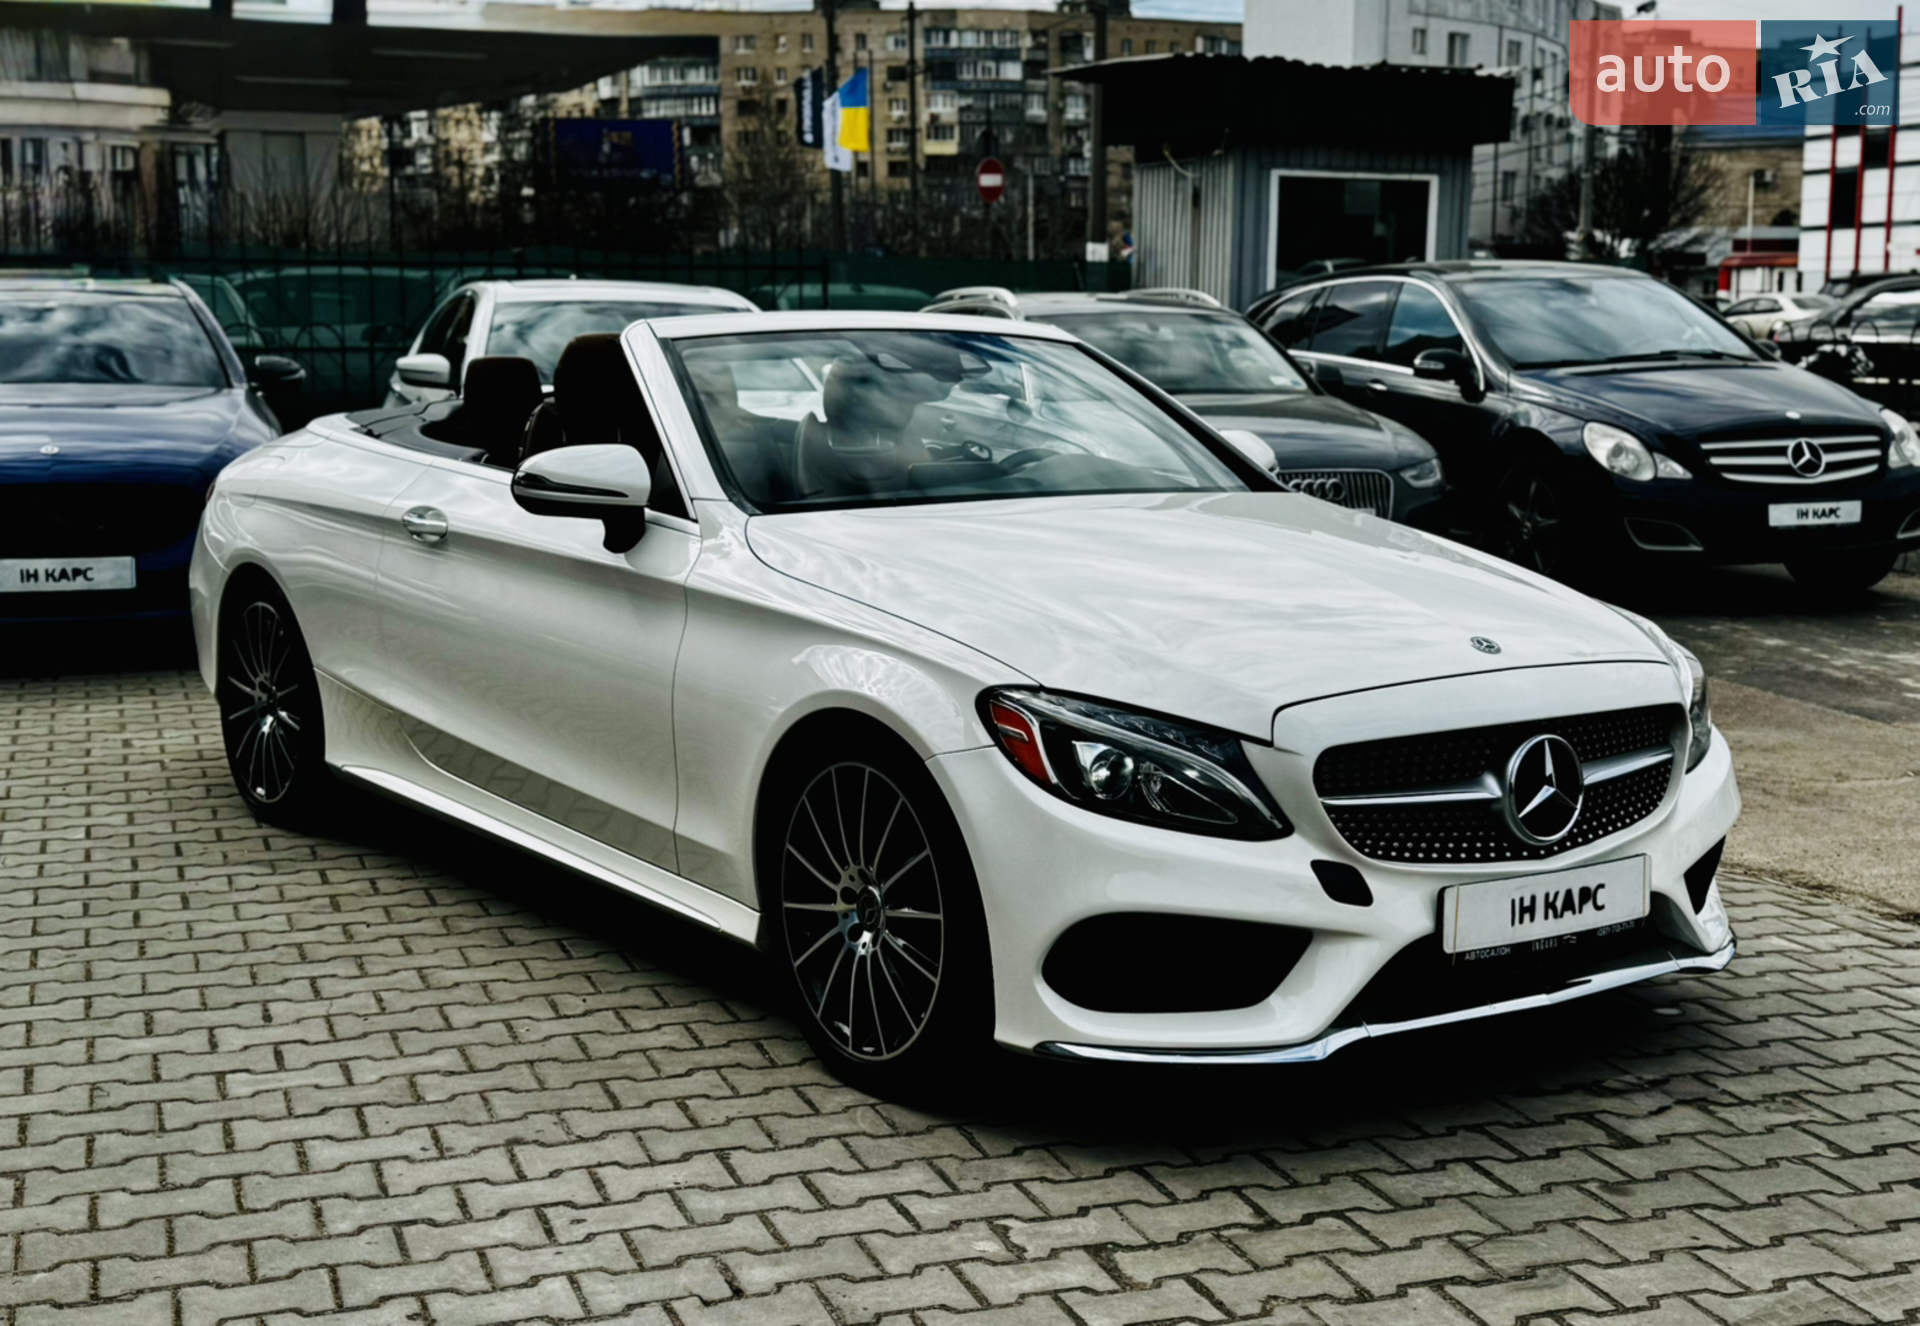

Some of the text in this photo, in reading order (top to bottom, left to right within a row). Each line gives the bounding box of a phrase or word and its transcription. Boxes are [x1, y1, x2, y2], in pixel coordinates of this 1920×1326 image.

[1812, 506, 1841, 519] КАРС
[20, 567, 95, 583] ІН КАРС
[1511, 883, 1606, 928] ІН КАРС
[1463, 946, 1511, 961] АВТОСАЛОН
